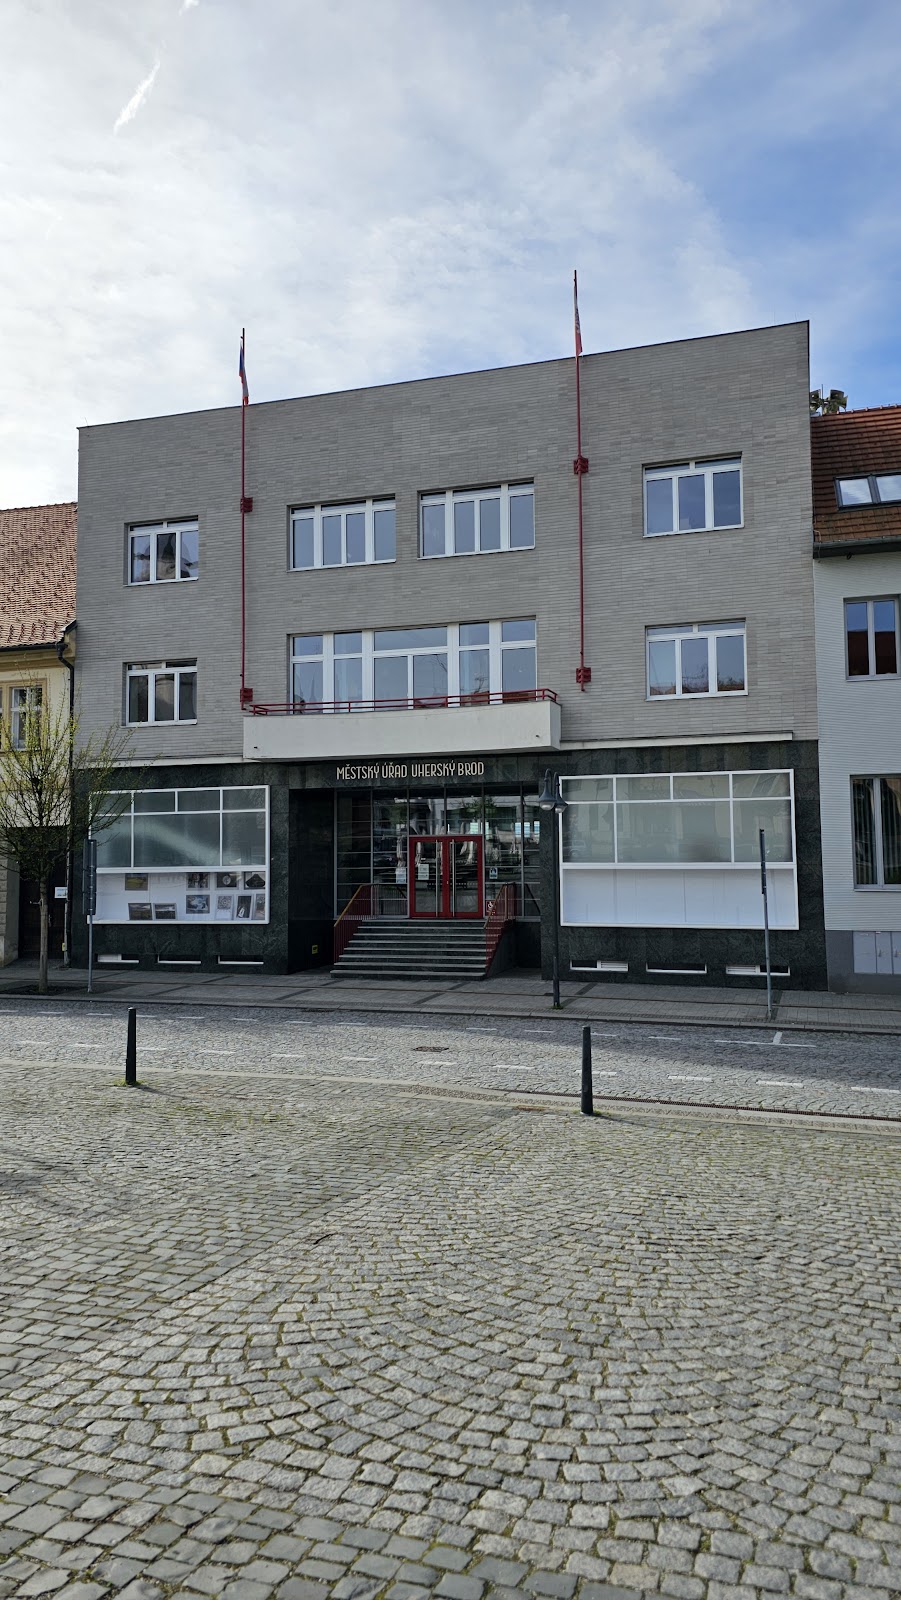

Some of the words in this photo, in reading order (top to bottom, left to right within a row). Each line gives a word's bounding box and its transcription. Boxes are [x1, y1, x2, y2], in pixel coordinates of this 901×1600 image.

[336, 763, 379, 780] MĚSTSKÝ
[381, 762, 408, 779] ÚŘAD
[411, 760, 456, 777] UHERSKÝ
[457, 761, 485, 776] BROD
